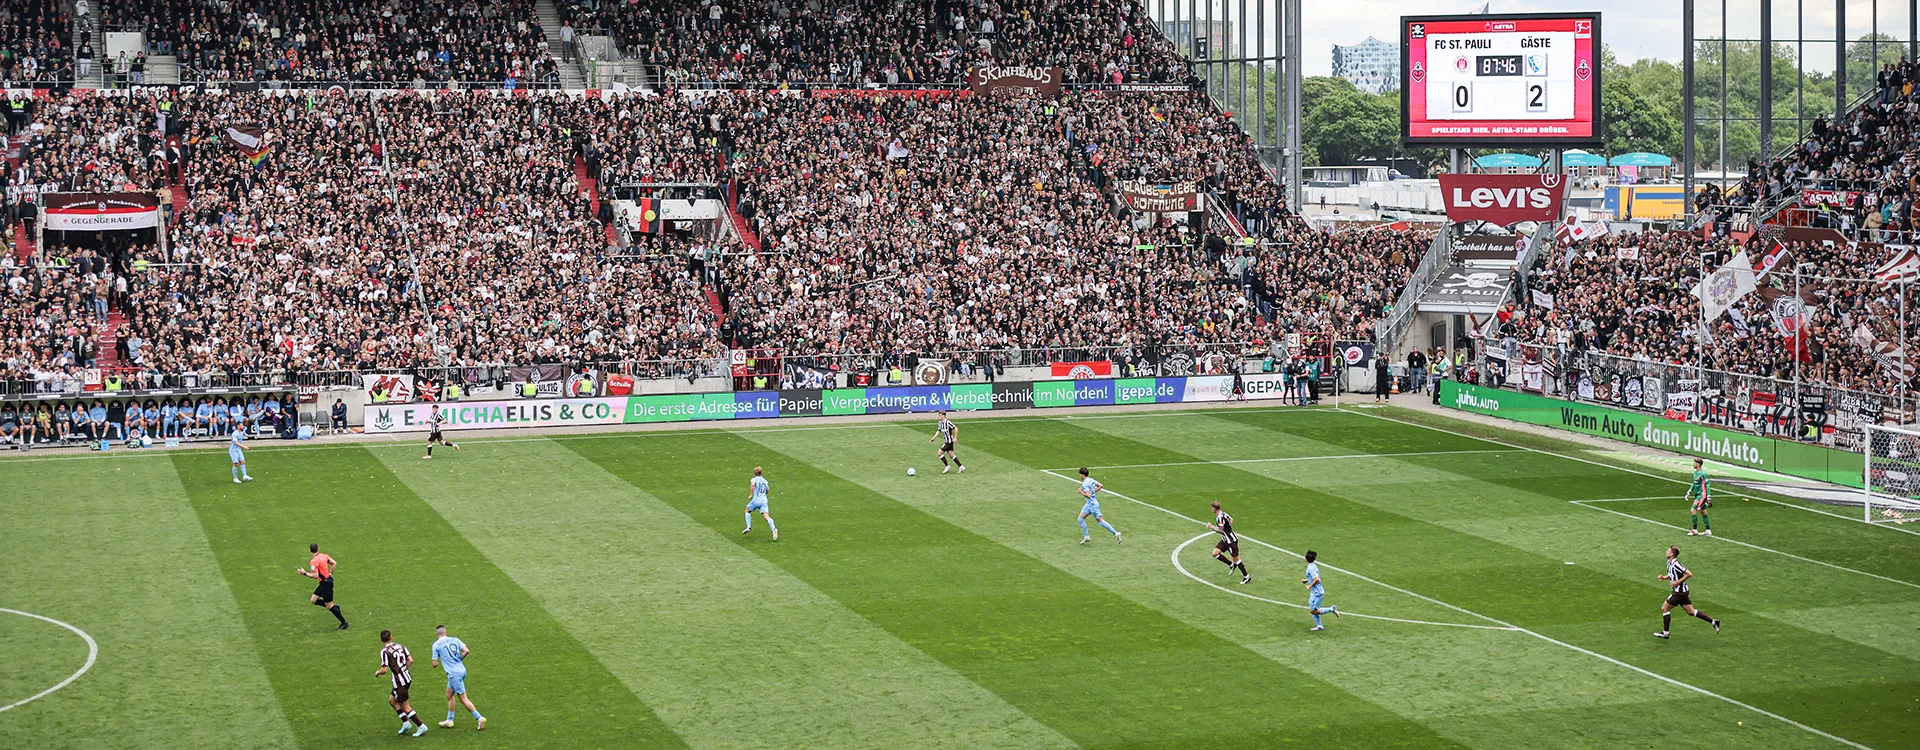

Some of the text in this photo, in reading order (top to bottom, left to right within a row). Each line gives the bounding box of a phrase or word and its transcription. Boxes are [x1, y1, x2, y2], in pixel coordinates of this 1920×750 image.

[1434, 39, 1492, 49] FC ST. PAULI
[1520, 35, 1551, 48] GÄSTE
[1482, 58, 1516, 74] 87:46
[978, 66, 1052, 86] SKINHEADS
[1132, 84, 1153, 92] PAULI
[1529, 84, 1543, 107] 2
[1456, 86, 1469, 108] 0
[1431, 126, 1570, 134] SPIELSTAND HIER. ASTRA-STAND DRÜBEN.
[1123, 180, 1196, 196] GLAUBE LIEBE
[1134, 197, 1186, 210] HOFFNUNG
[1488, 243, 1503, 251] has
[1504, 244, 1514, 252] no
[1243, 380, 1283, 394] IGEPA
[634, 382, 1174, 417] Die erste Adresse für Papier, Verpackungen & Werbetechnik im Norden! igepa.de
[404, 409, 424, 426] E.
[558, 402, 574, 420] &
[581, 402, 617, 420] CO.
[1561, 407, 1764, 466] Wenn Auto, dann JuhuAuto.
[393, 649, 406, 668] 25
[444, 643, 458, 658] 19
